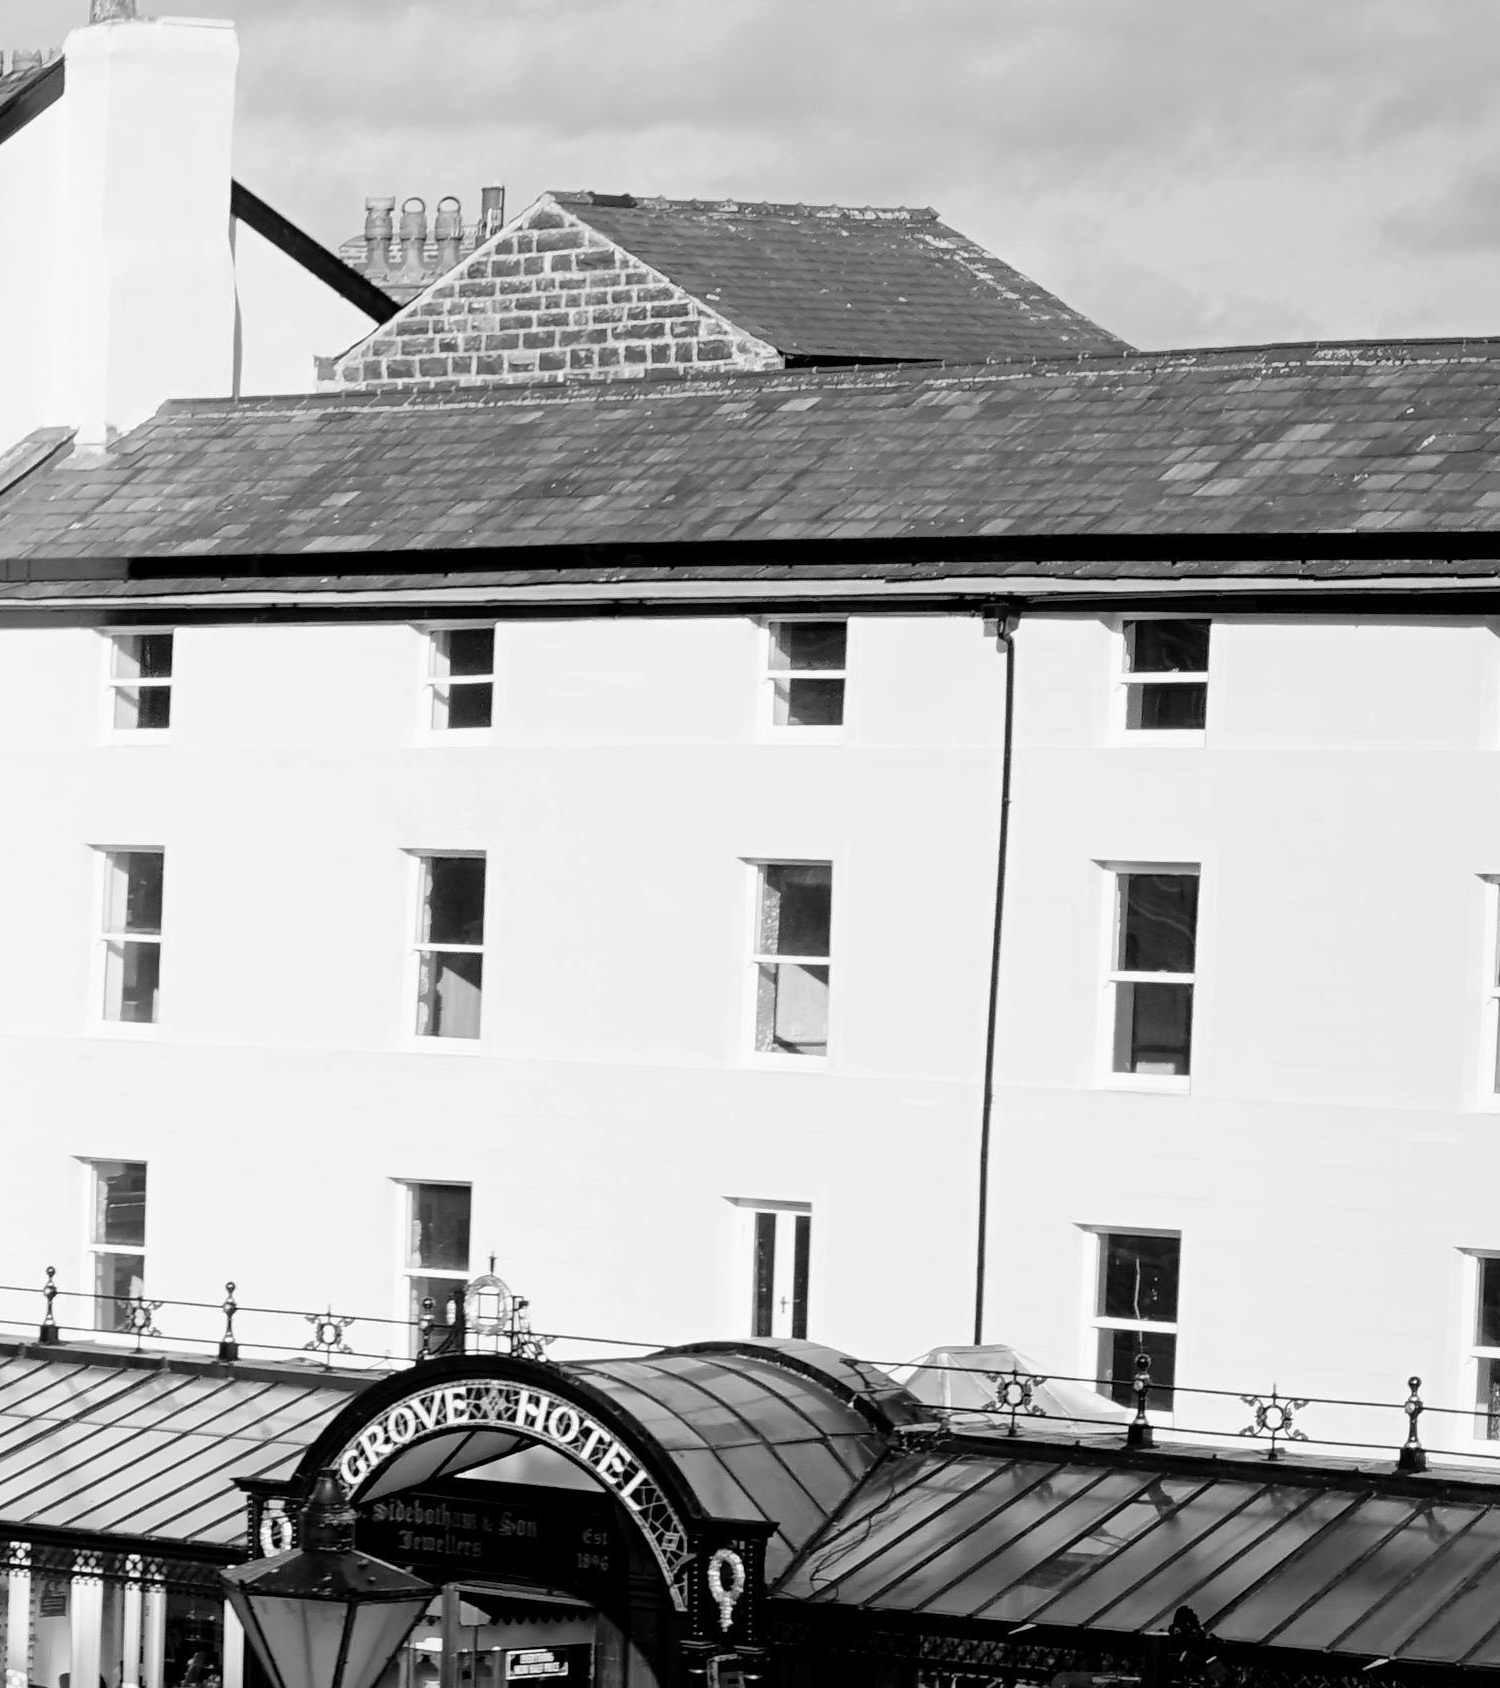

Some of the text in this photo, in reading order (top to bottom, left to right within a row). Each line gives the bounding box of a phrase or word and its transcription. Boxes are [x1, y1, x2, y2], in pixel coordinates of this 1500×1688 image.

[340, 1386, 648, 1512] GROVE HOTEL
[371, 1500, 477, 1531] Sidebotham
[498, 1512, 538, 1539] Son
[399, 1530, 483, 1558] Jewellers
